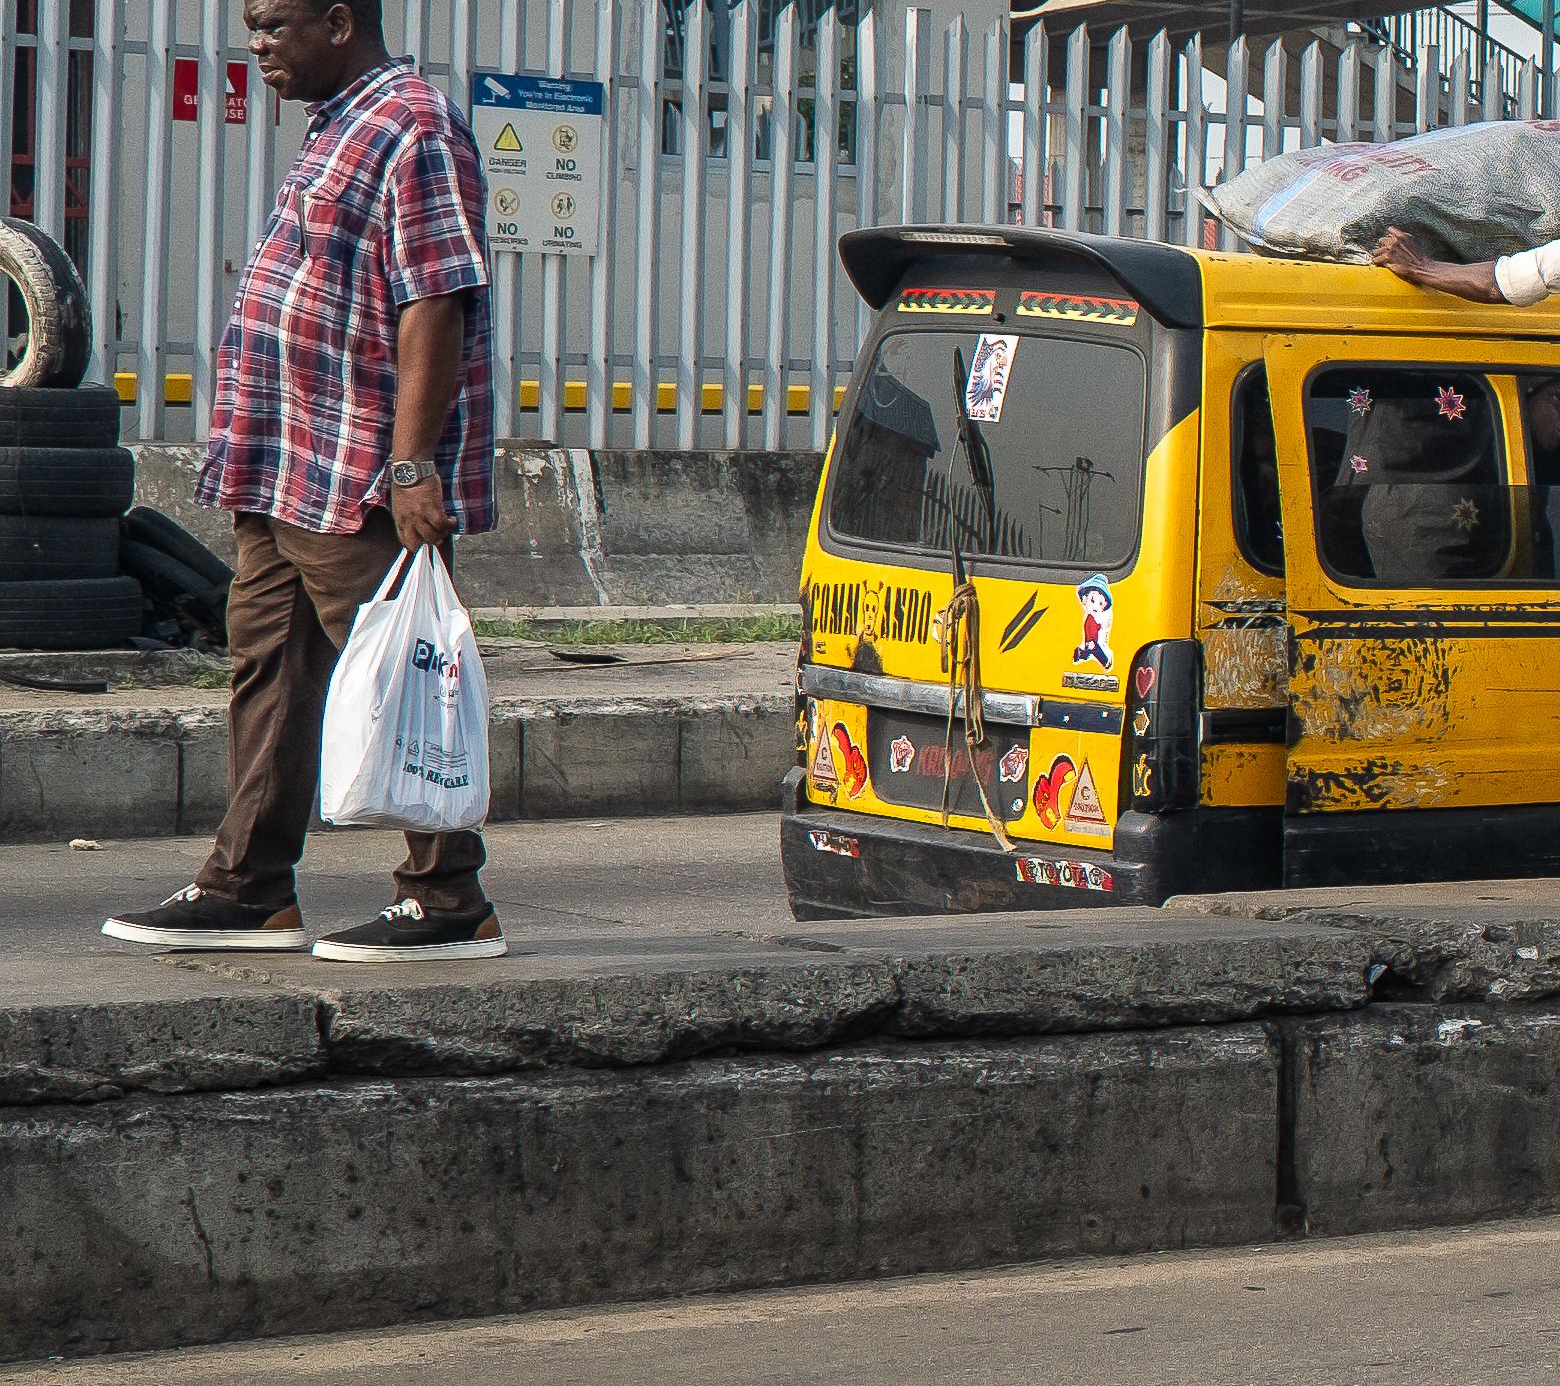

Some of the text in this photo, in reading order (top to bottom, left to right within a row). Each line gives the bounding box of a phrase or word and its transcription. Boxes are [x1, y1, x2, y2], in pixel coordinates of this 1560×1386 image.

[555, 158, 577, 172] NO
[496, 222, 518, 236] NO
[553, 225, 575, 239] NO
